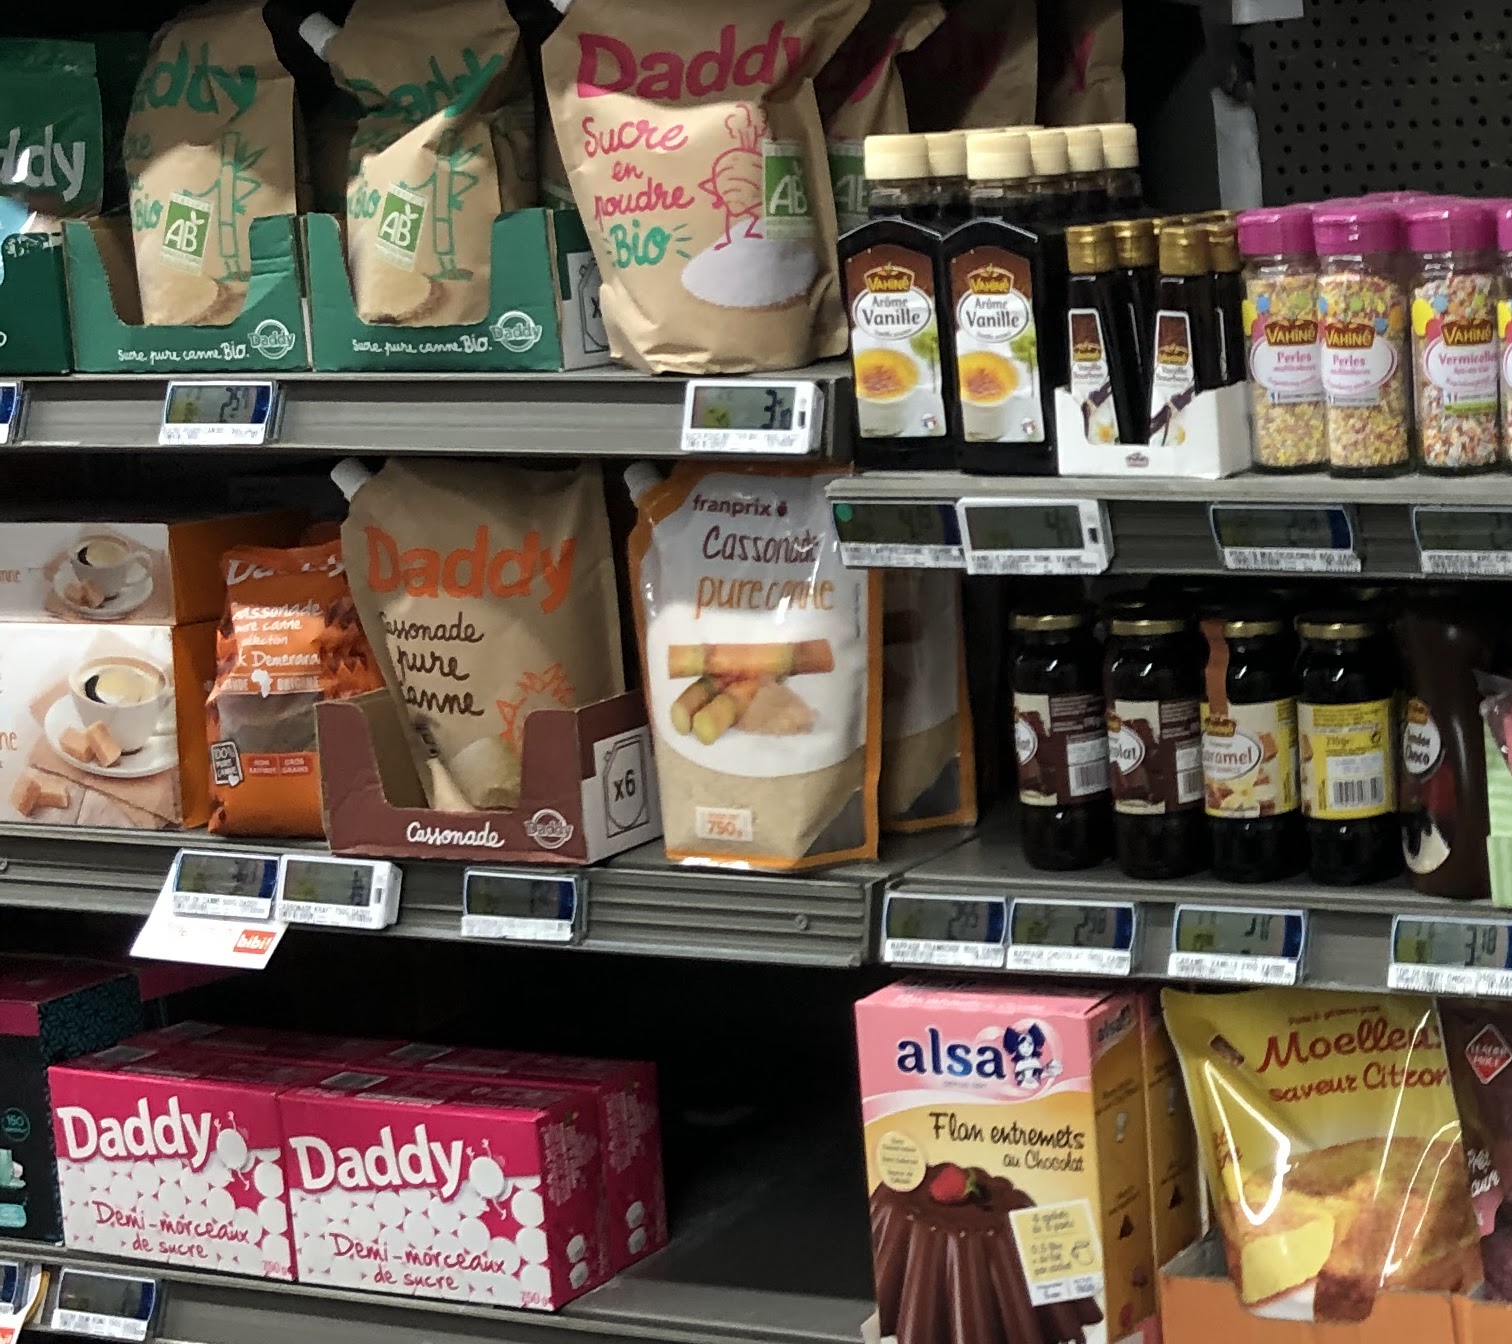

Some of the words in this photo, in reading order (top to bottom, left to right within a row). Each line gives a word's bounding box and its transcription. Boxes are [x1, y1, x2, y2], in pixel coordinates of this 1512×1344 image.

[581, 117, 690, 156] Sucre
[609, 162, 645, 184] en
[592, 169, 695, 224] poudre
[610, 219, 669, 269] Bio
[872, 295, 910, 310] Arôme
[974, 298, 1011, 311] Arôme
[862, 306, 922, 327] Vanille
[965, 309, 1020, 331] Vanille
[117, 348, 149, 364] Sucre
[150, 347, 180, 365] pure
[181, 346, 219, 362] canne
[352, 339, 386, 354] Sucre
[388, 339, 418, 358] pure
[420, 338, 458, 355] canne
[692, 494, 774, 517] franprix
[367, 524, 577, 614] Daddy
[612, 769, 637, 800] x6
[405, 822, 506, 849] Cassonade
[524, 814, 573, 841] Daddy
[896, 1026, 1007, 1082] alsa
[56, 1095, 221, 1169] Daddy
[927, 1111, 984, 1144] Flan
[990, 1121, 1086, 1150] entremets
[289, 1123, 466, 1197] Daddy
[1002, 1151, 1021, 1167] au
[1024, 1149, 1086, 1173] Chocolat
[94, 1198, 251, 1247] Demi-morceaux
[131, 1239, 149, 1254] de
[150, 1239, 209, 1263] sucre
[329, 1230, 508, 1278] Demi-morceaux
[372, 1268, 394, 1286] de
[400, 1271, 461, 1295] sucre
